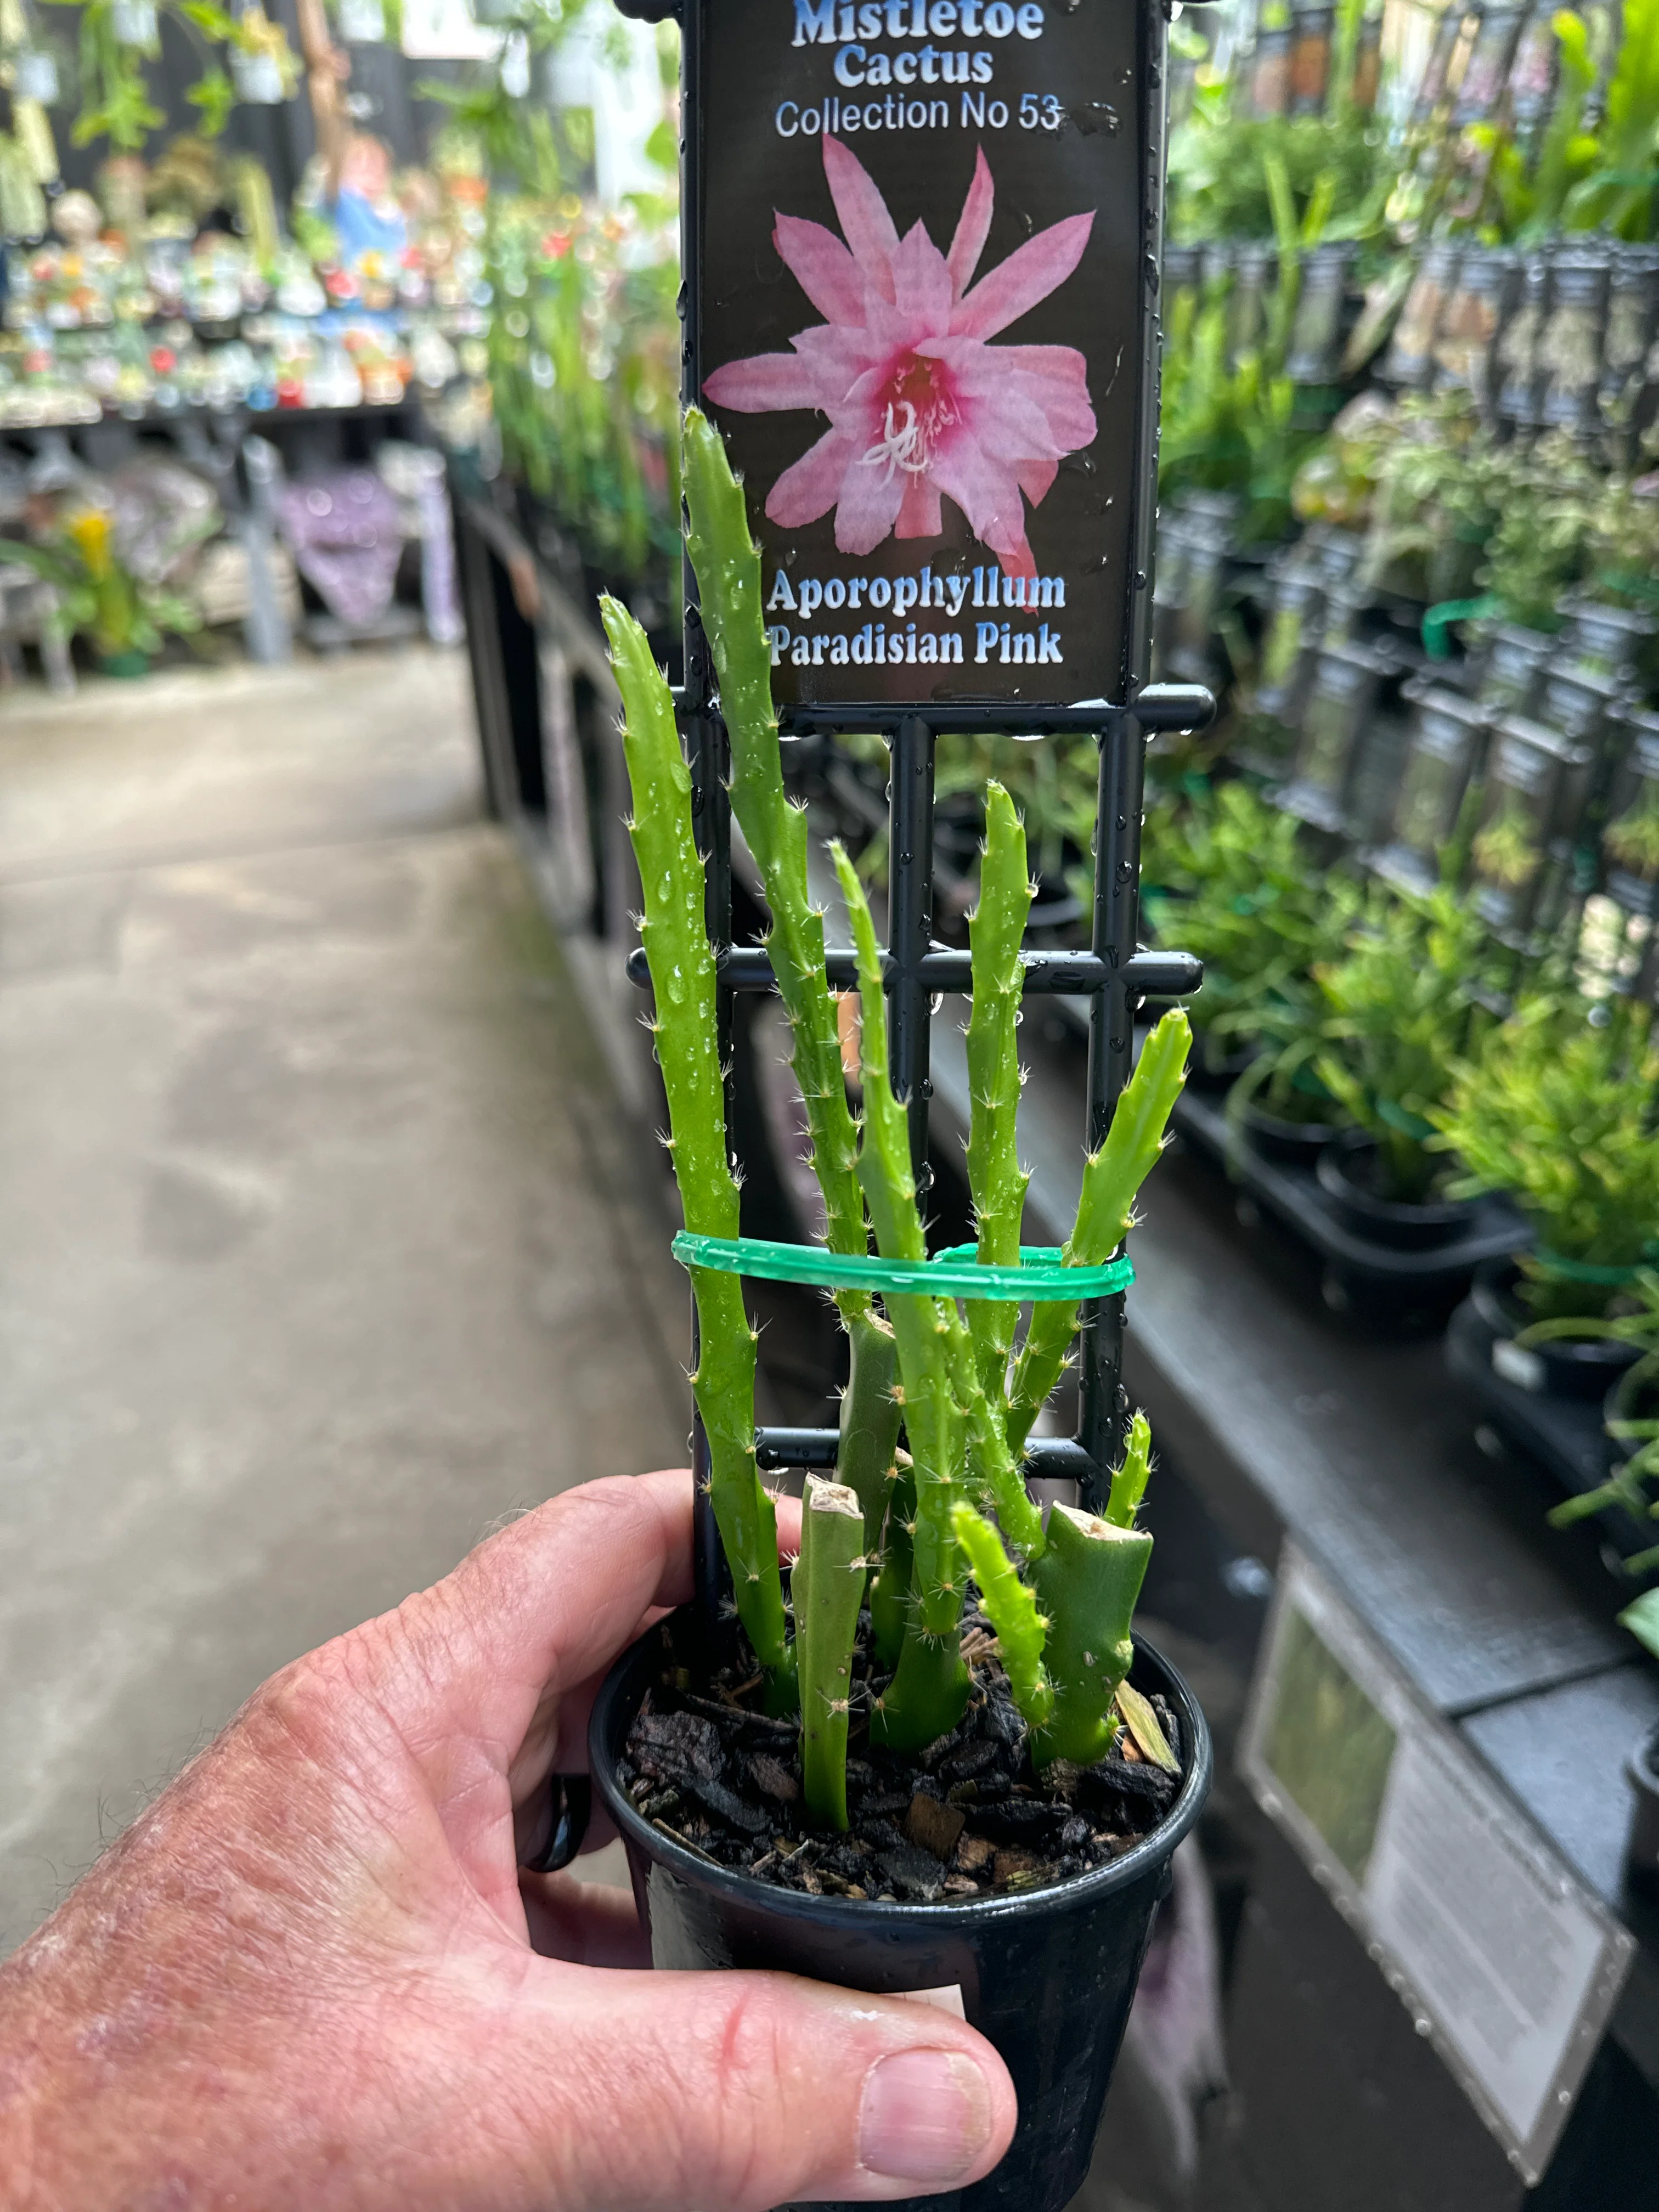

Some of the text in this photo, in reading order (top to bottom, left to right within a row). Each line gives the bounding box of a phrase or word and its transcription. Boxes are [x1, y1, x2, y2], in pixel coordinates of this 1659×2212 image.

[791, 0, 1045, 47] Mistletoe
[833, 43, 994, 88] Cactus
[775, 91, 1061, 138] Collection No 53
[766, 566, 1066, 619] Aporophyllum
[769, 622, 1064, 666] Paradisian Pink
